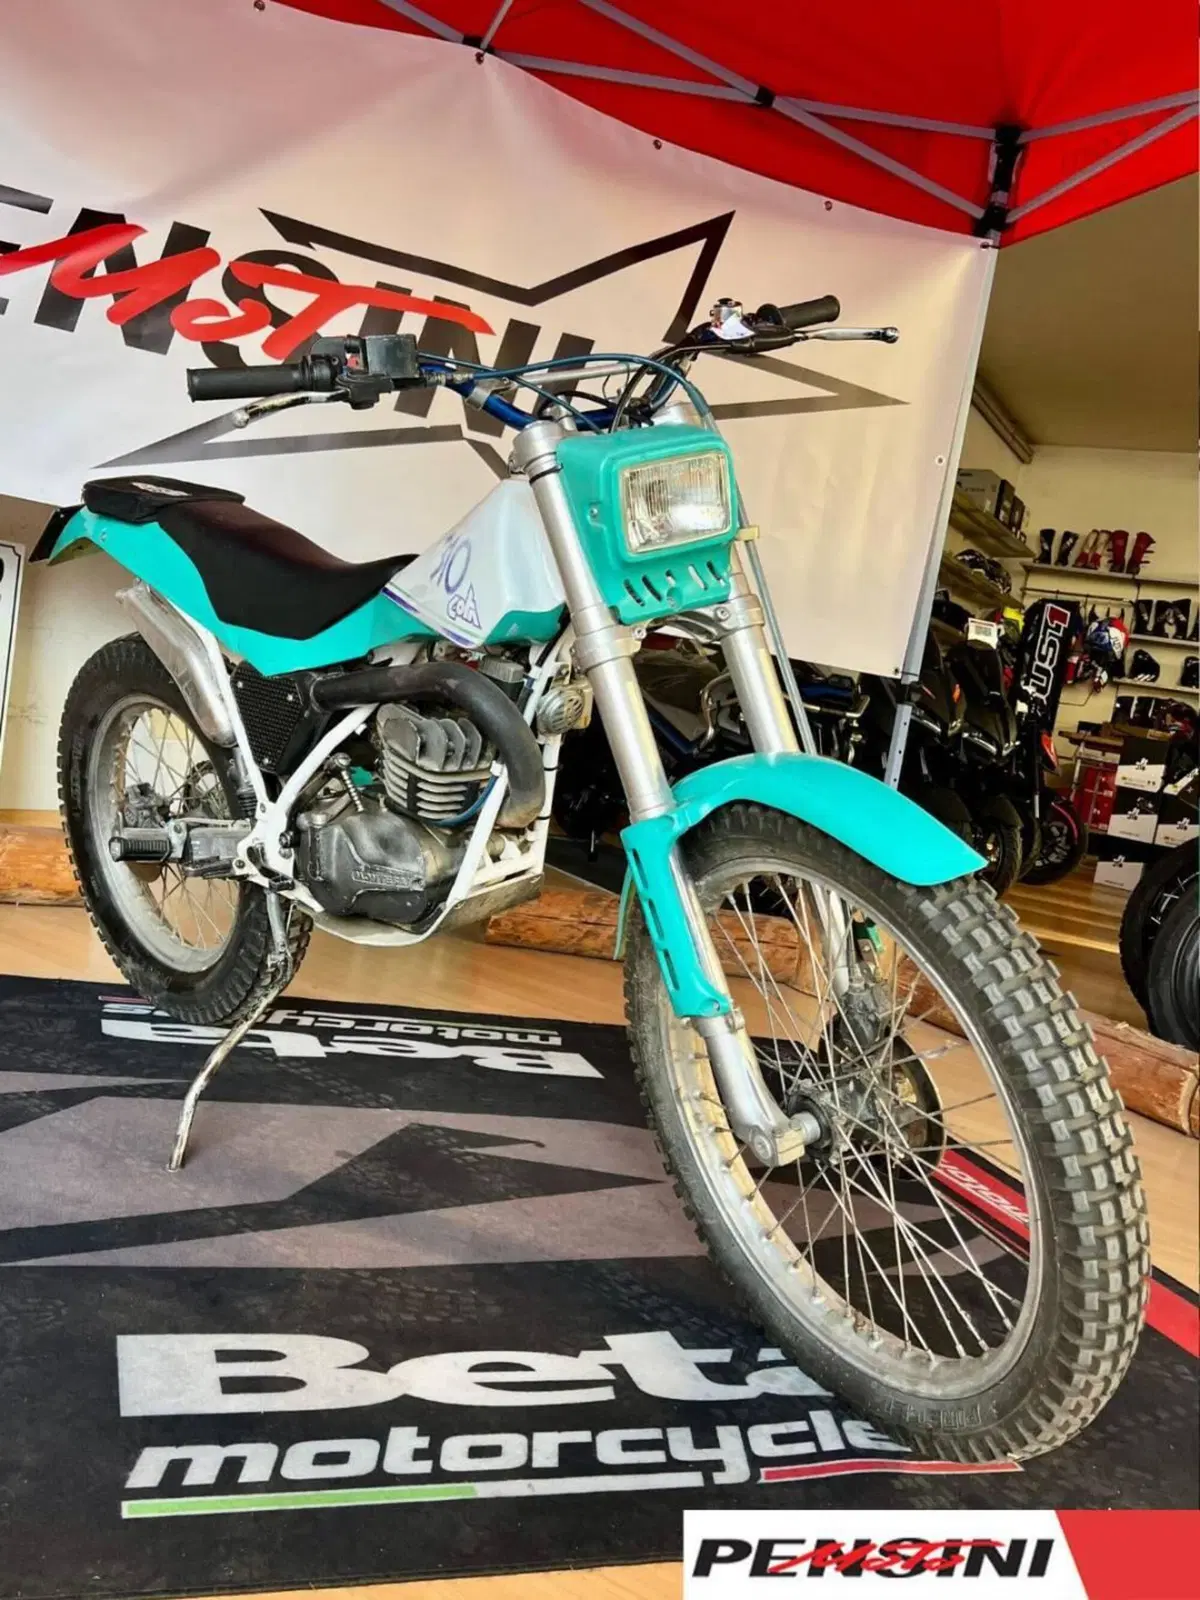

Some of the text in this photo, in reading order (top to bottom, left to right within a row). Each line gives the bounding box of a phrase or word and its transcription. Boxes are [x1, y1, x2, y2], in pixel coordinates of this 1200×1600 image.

[1027, 603, 1071, 705] UST1
[101, 1018, 604, 1079] Beta
[123, 1410, 912, 1489] motorcycle
